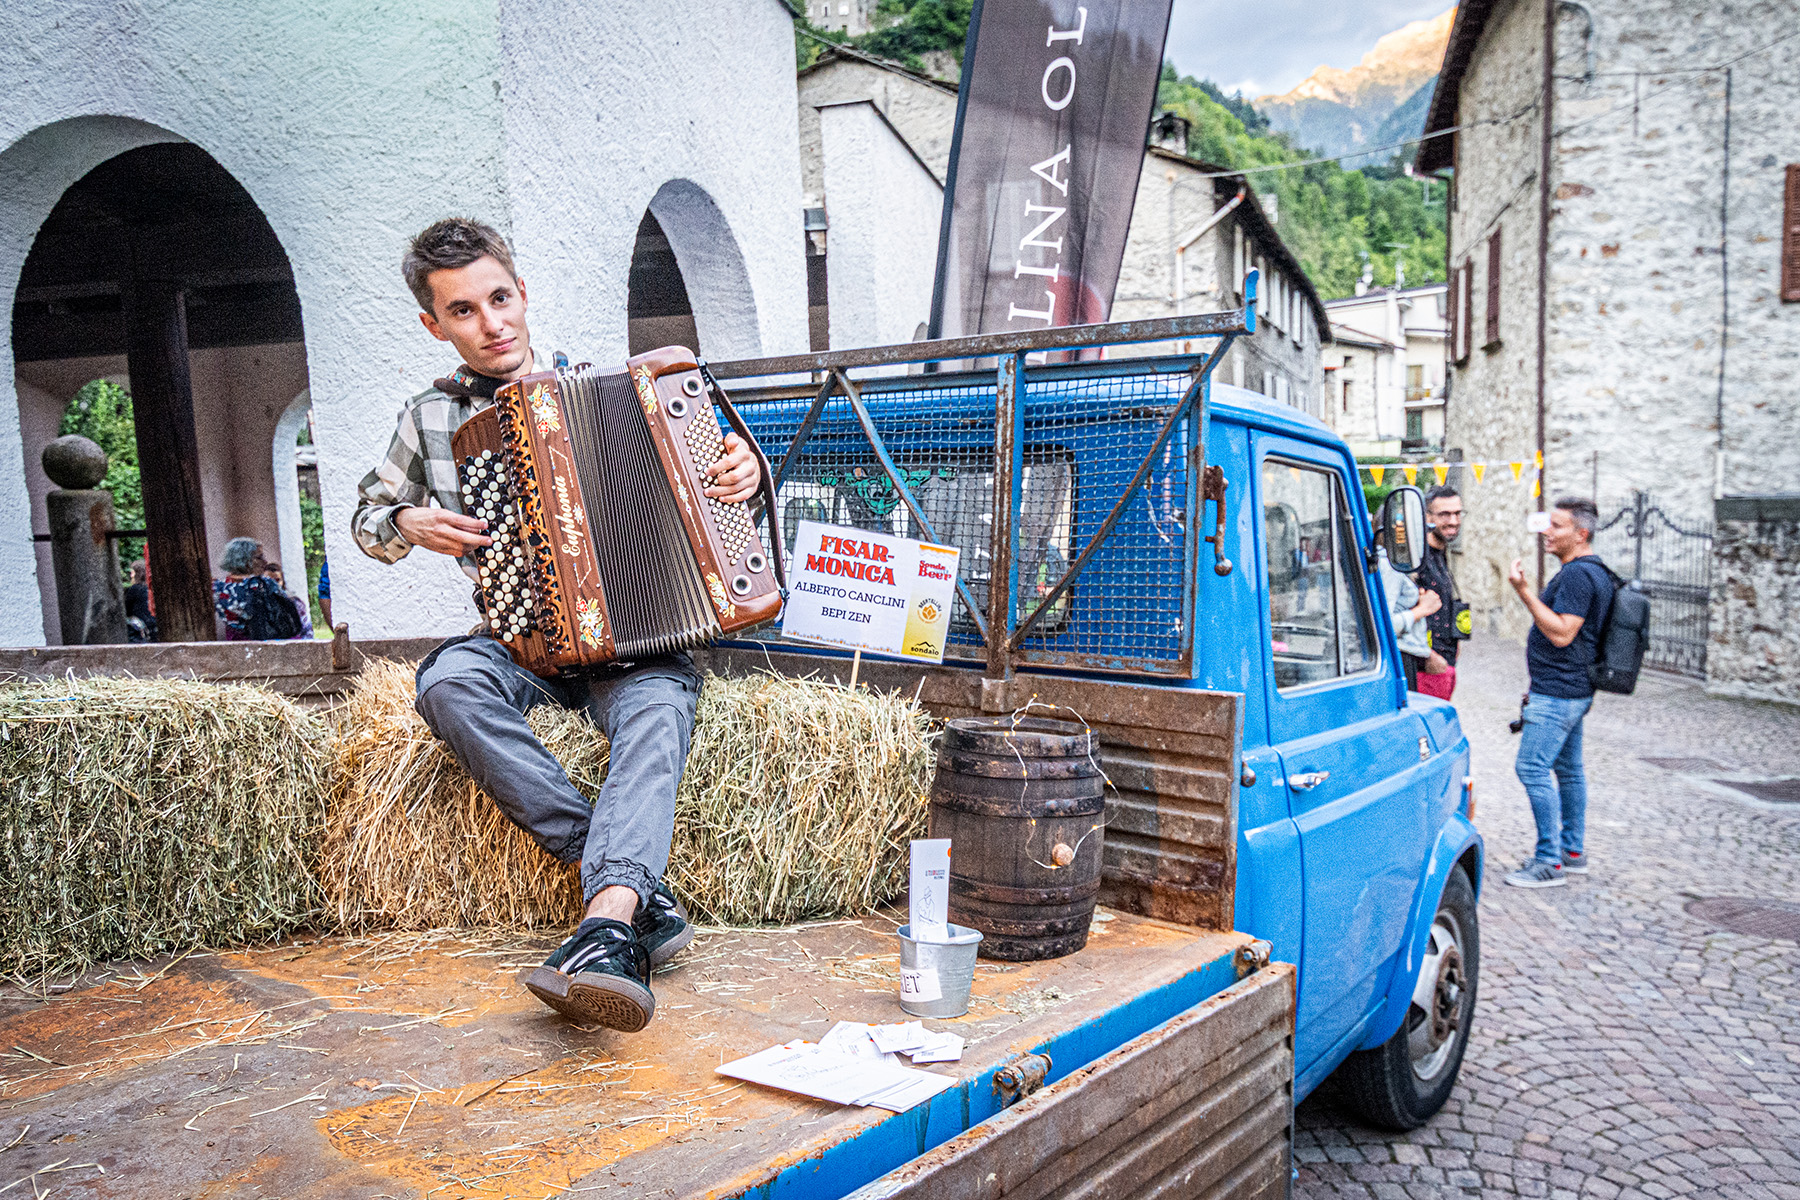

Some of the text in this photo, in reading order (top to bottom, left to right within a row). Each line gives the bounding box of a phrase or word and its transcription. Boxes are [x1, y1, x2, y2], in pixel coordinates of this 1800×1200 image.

[552, 475, 584, 556] Euphonia
[819, 534, 895, 562] FISAR-
[805, 554, 896, 586] MONICA
[918, 564, 952, 581] Beer
[795, 581, 905, 609] ALBERTO CANCLINI
[821, 606, 872, 623] BEPI ZEN
[911, 646, 939, 656] sondalo
